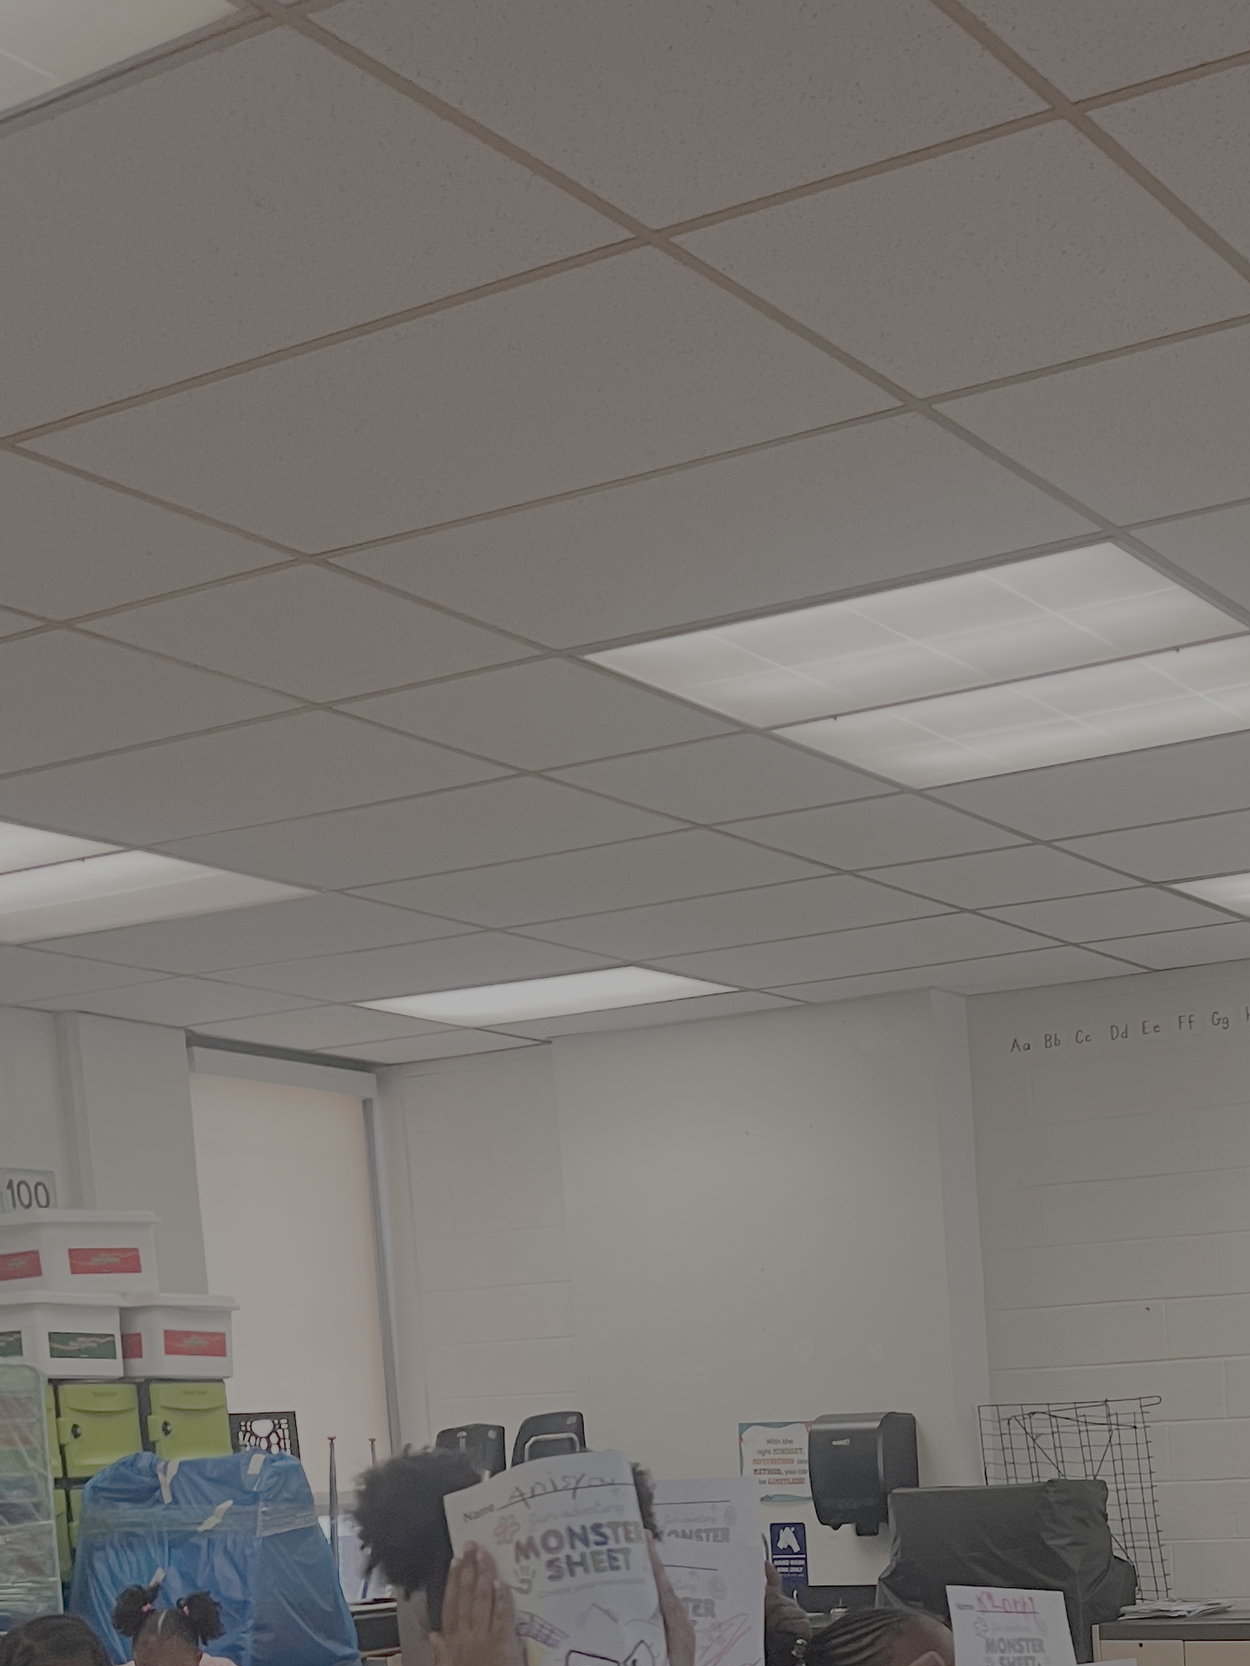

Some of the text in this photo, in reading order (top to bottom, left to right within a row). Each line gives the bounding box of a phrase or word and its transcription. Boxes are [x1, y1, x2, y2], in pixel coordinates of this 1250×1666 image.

[1011, 1039, 1031, 1052] Aa
[1045, 1034, 1060, 1049] Bb
[1075, 1030, 1091, 1044] Cc
[1111, 1025, 1128, 1040] Dd
[1143, 1021, 1161, 1035] Ee
[1178, 1015, 1195, 1030] Ff
[1212, 1012, 1229, 1029] Gg
[7, 1180, 50, 1209] 100
[660, 1527, 731, 1543] ONSTER
[545, 1547, 632, 1582] SHEET
[985, 1637, 1046, 1654] MONSTER
